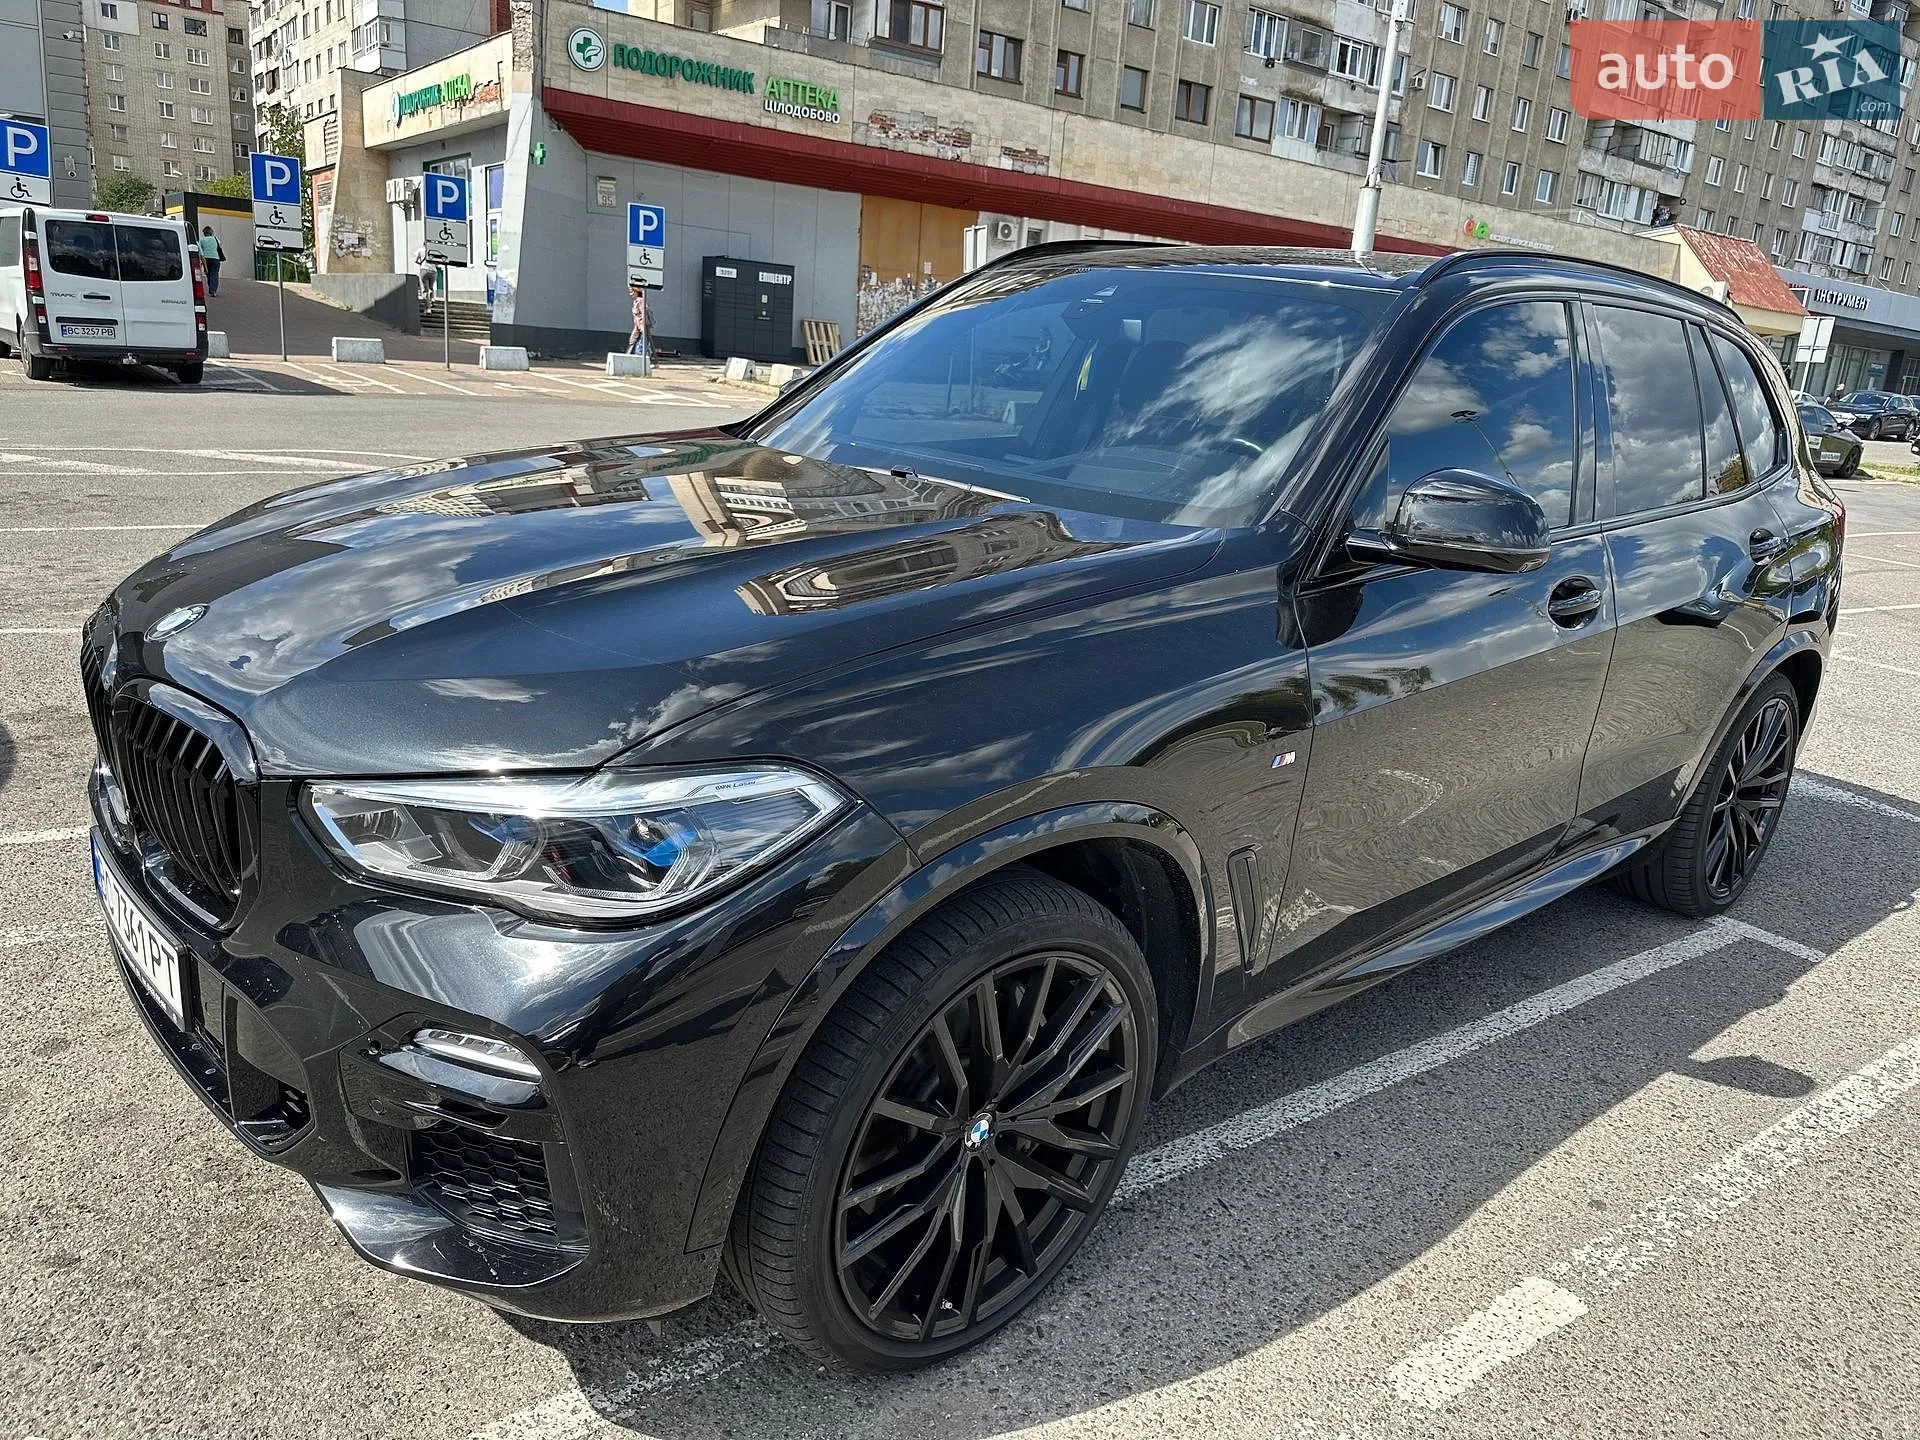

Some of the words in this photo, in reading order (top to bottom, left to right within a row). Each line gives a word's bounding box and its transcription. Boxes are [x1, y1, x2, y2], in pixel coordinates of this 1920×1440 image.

[613, 43, 756, 95] ПОДОРОЖНИК
[764, 75, 840, 110] АПТЕКА
[763, 99, 841, 125] ЦІЛОДОБОВО
[7, 127, 38, 166] P
[265, 160, 291, 197] P
[437, 180, 459, 214] P
[639, 210, 658, 241] P
[1815, 288, 1871, 311] ІНСТРУМЕНТ
[81, 327, 99, 336] 3257
[113, 883, 147, 967] 7361
[149, 929, 175, 999] PT
